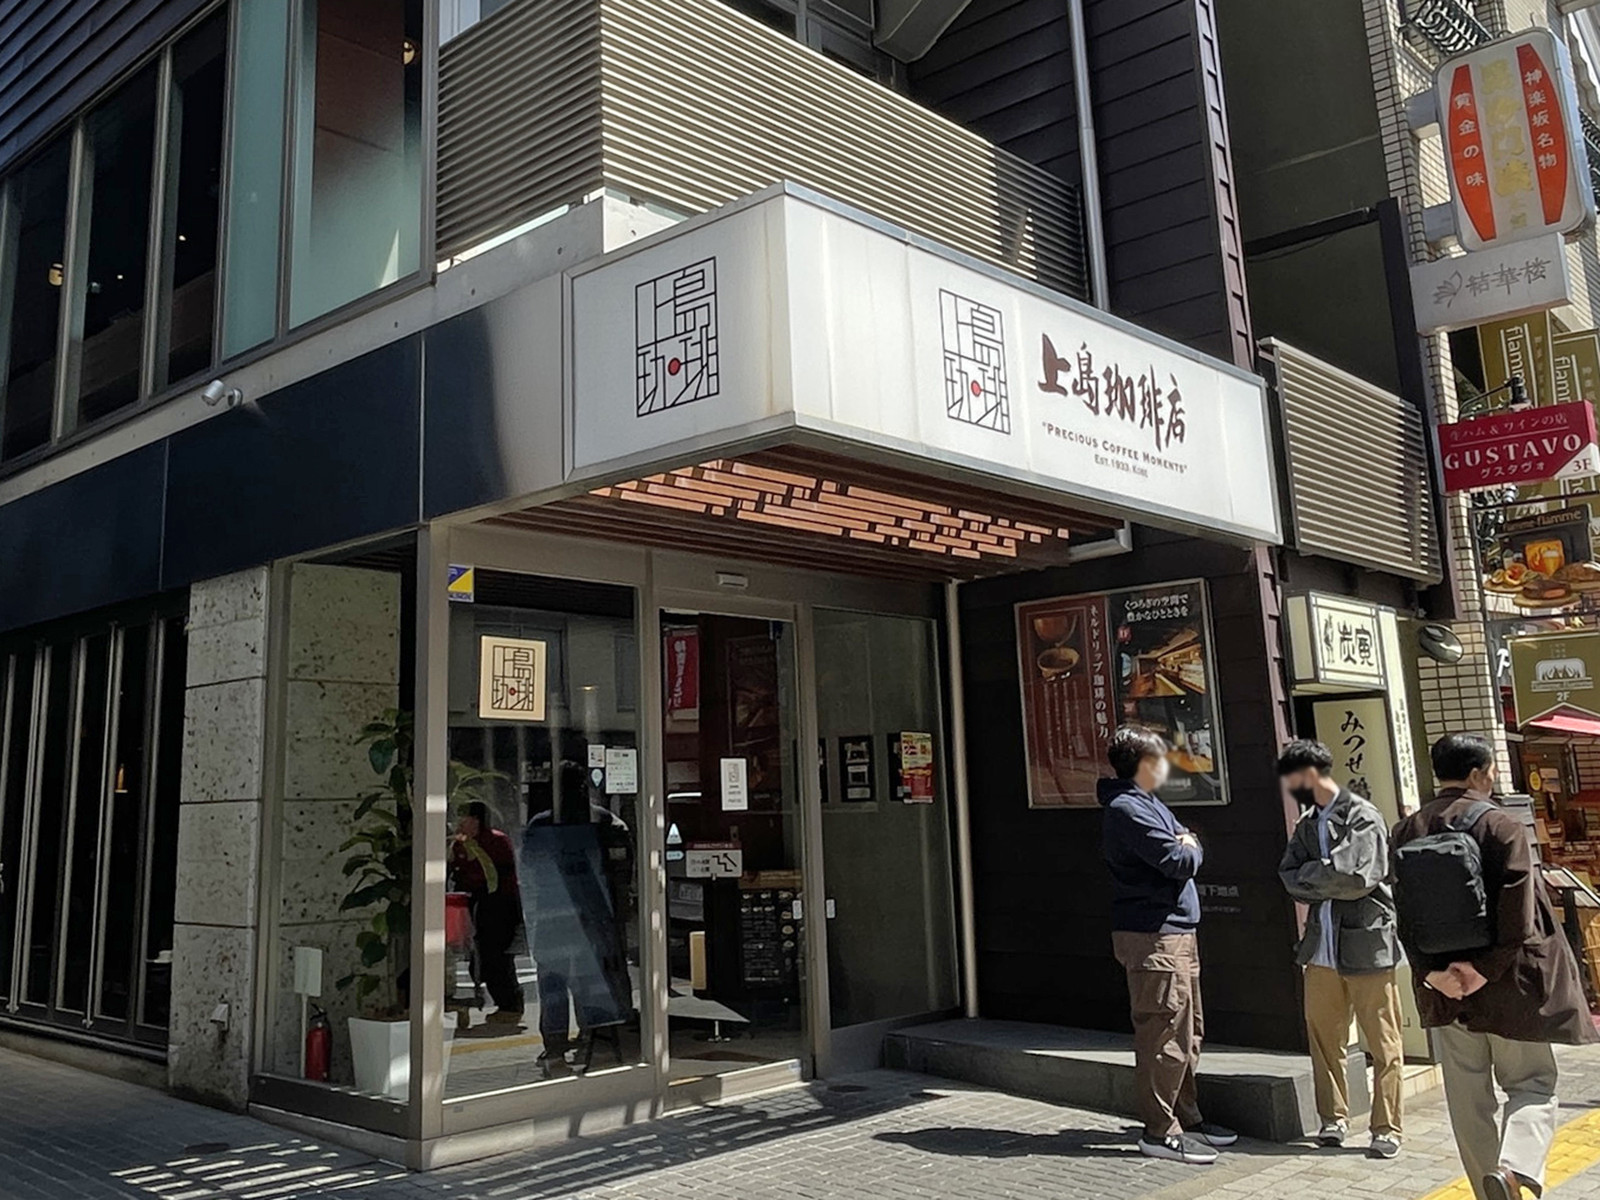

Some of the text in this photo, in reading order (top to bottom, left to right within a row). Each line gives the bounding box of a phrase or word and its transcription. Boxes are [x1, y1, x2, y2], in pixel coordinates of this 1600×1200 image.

[1524, 69, 1557, 169] 神楽坂名物
[1454, 93, 1485, 187] 黄金の味
[1466, 257, 1552, 297] 結華楼
[1037, 333, 1186, 452] 上島珈琲店
[1102, 440, 1139, 461] COFFEE
[1444, 433, 1582, 470] GUSTAVO
[1573, 458, 1591, 473] 3F
[1090, 606, 1109, 739] ネルドリップ珈琲の魅力
[1556, 691, 1571, 702] 2F
